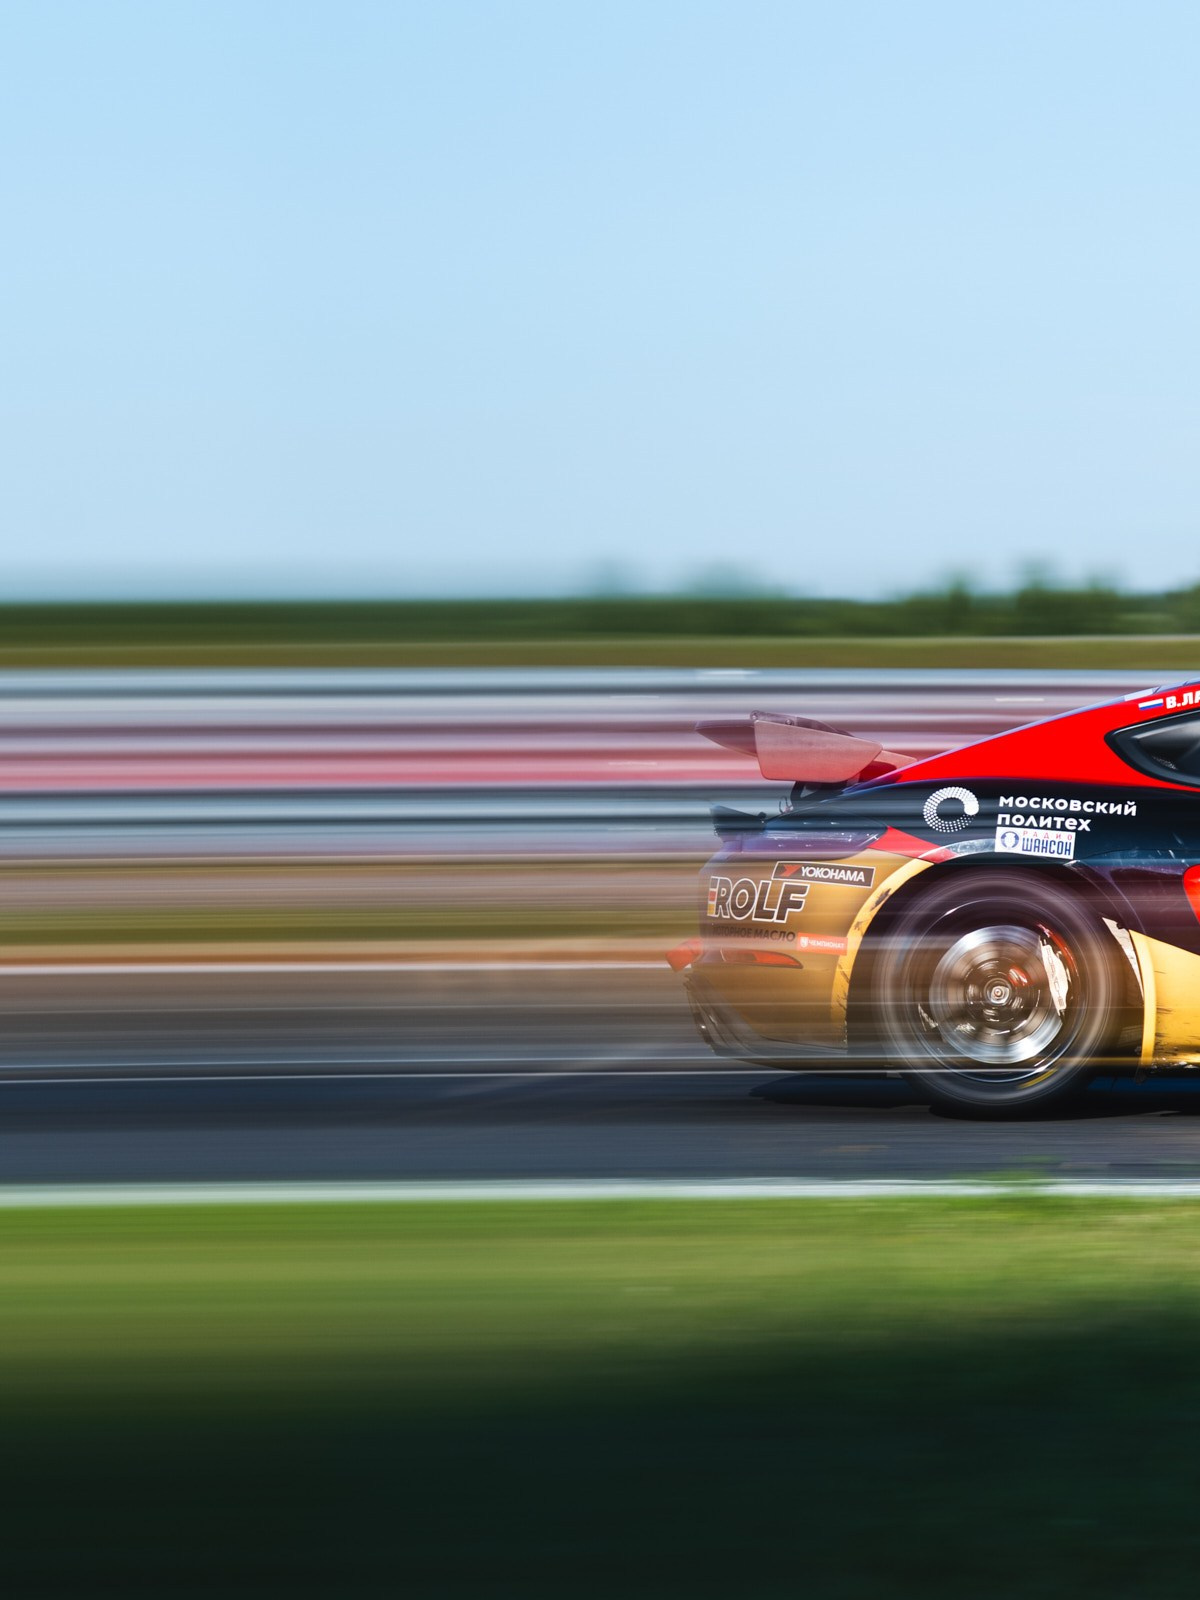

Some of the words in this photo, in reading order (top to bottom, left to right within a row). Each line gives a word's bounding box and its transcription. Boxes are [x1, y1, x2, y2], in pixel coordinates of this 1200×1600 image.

[1022, 830, 1073, 841] РАДИО
[1022, 837, 1072, 856] ШАНСОН
[801, 867, 865, 882] YOKOHAMA
[714, 876, 810, 923] ROLF
[755, 928, 796, 942] МАСЛО
